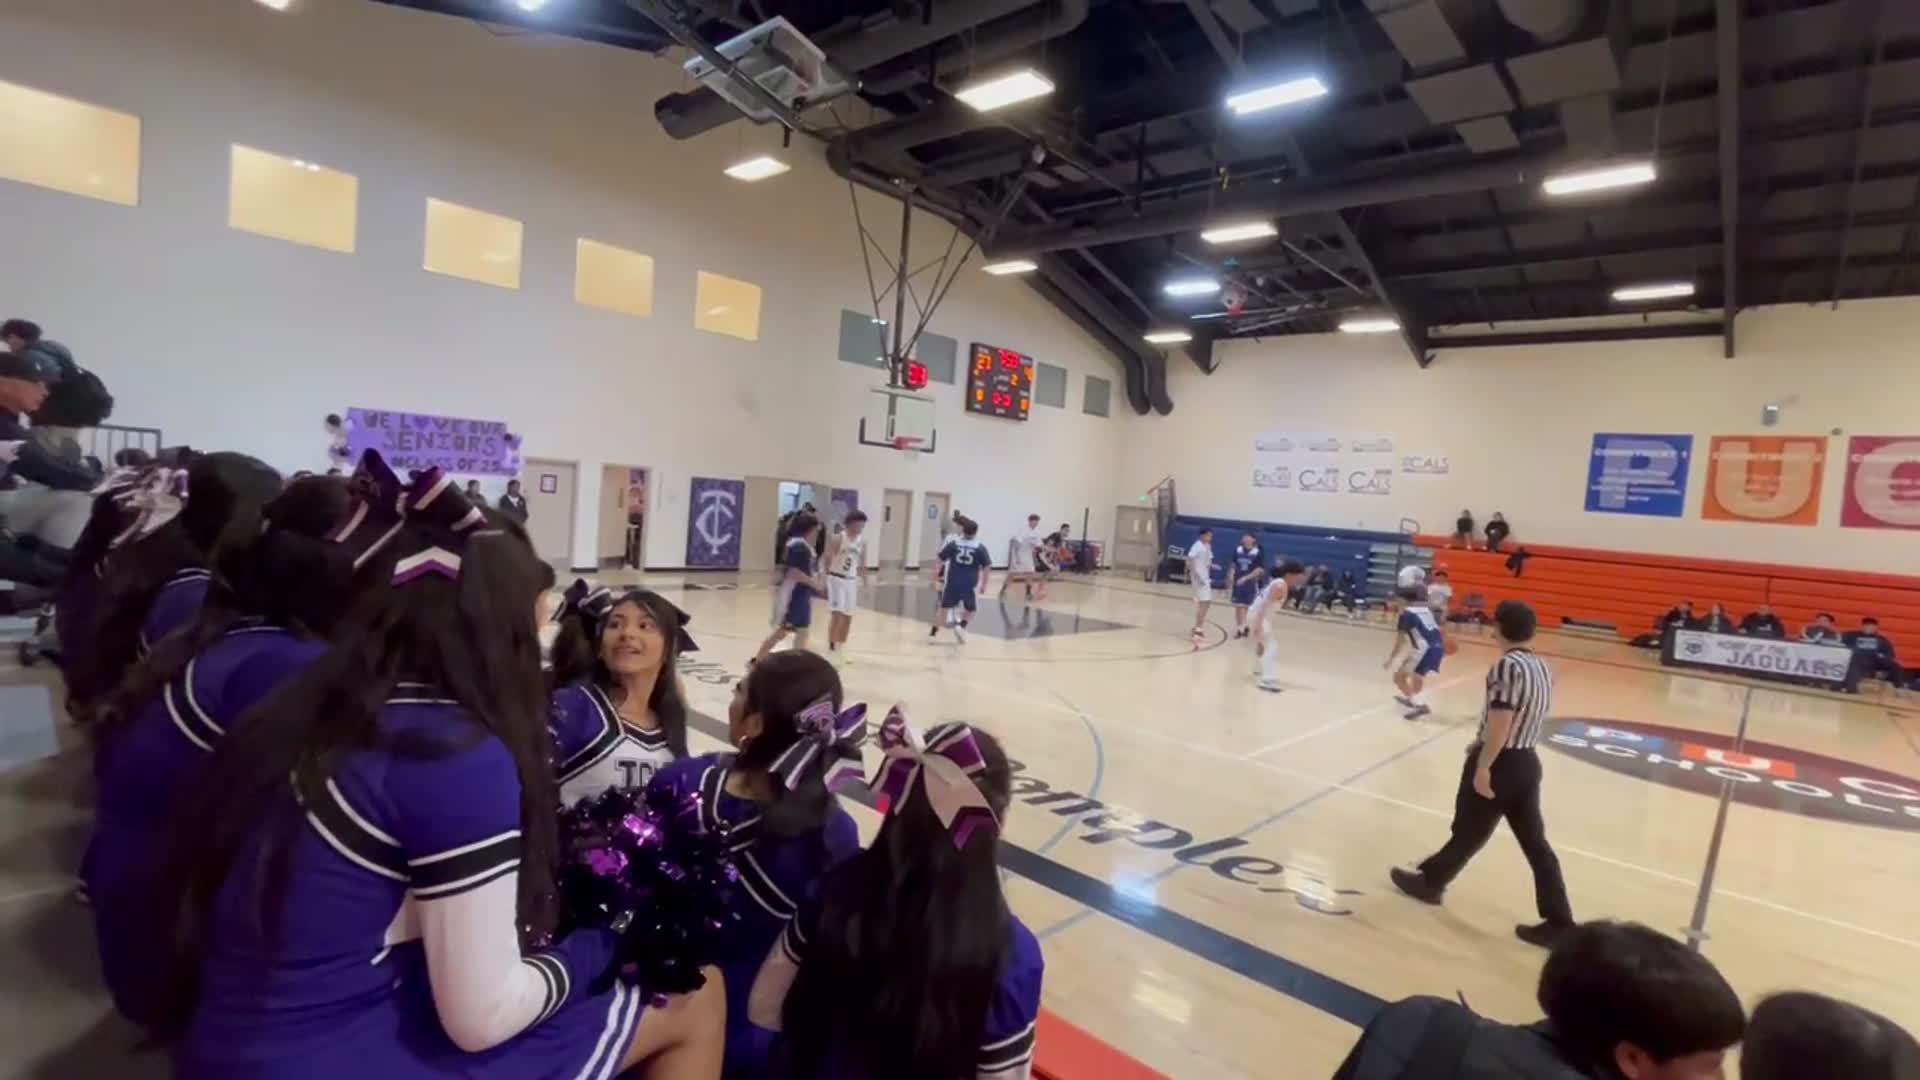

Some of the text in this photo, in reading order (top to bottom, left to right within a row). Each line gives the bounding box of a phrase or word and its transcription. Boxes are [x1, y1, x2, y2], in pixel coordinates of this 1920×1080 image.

[382, 430, 497, 457] SENIORS
[956, 547, 974, 565] 25
[1727, 650, 1845, 679] JAGUARS
